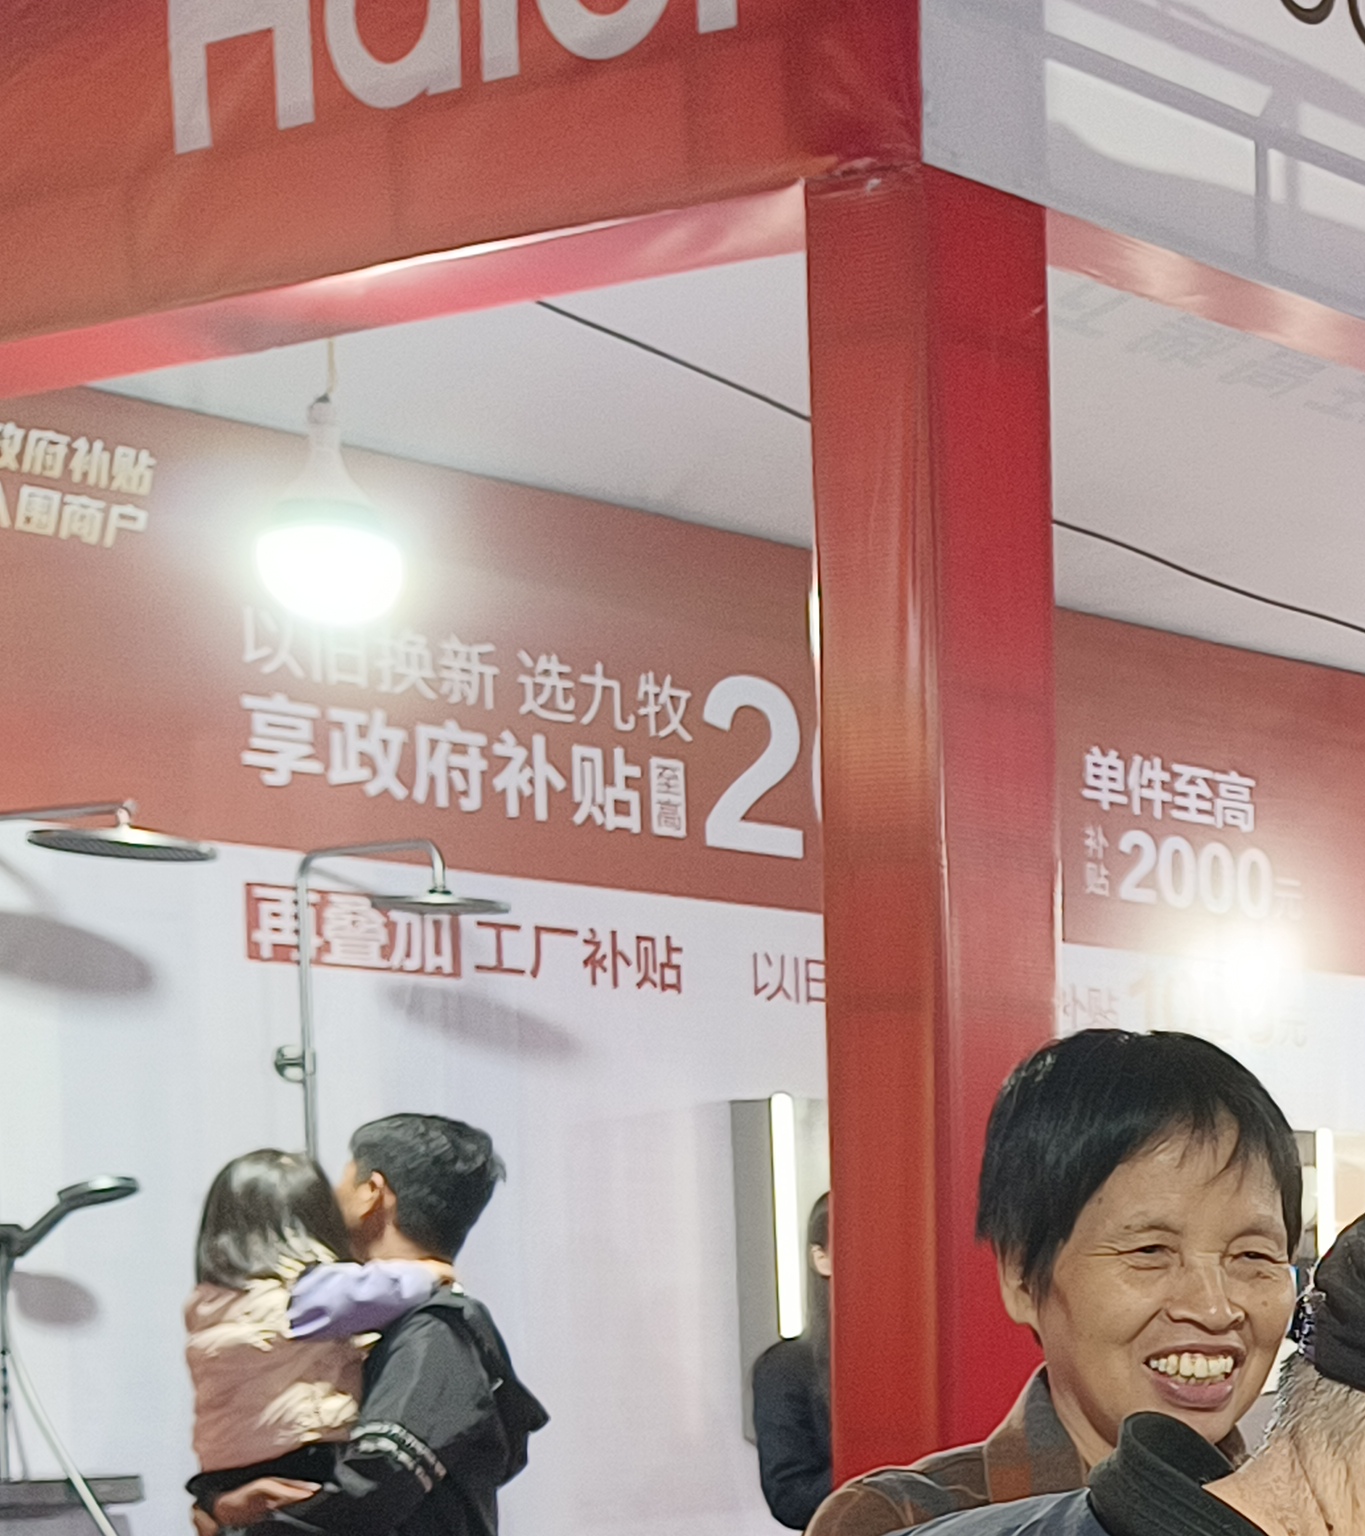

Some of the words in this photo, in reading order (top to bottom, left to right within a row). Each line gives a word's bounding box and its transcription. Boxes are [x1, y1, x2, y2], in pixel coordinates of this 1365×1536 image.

[0, 421, 157, 496] 政府补贴
[242, 604, 499, 710] 以旧换新
[516, 649, 693, 743] 选九牧
[240, 693, 644, 835] 享政府补贴
[1081, 746, 1256, 832] 单件至高
[251, 887, 455, 974] 再叠加
[474, 917, 684, 994] 工厂补贴
